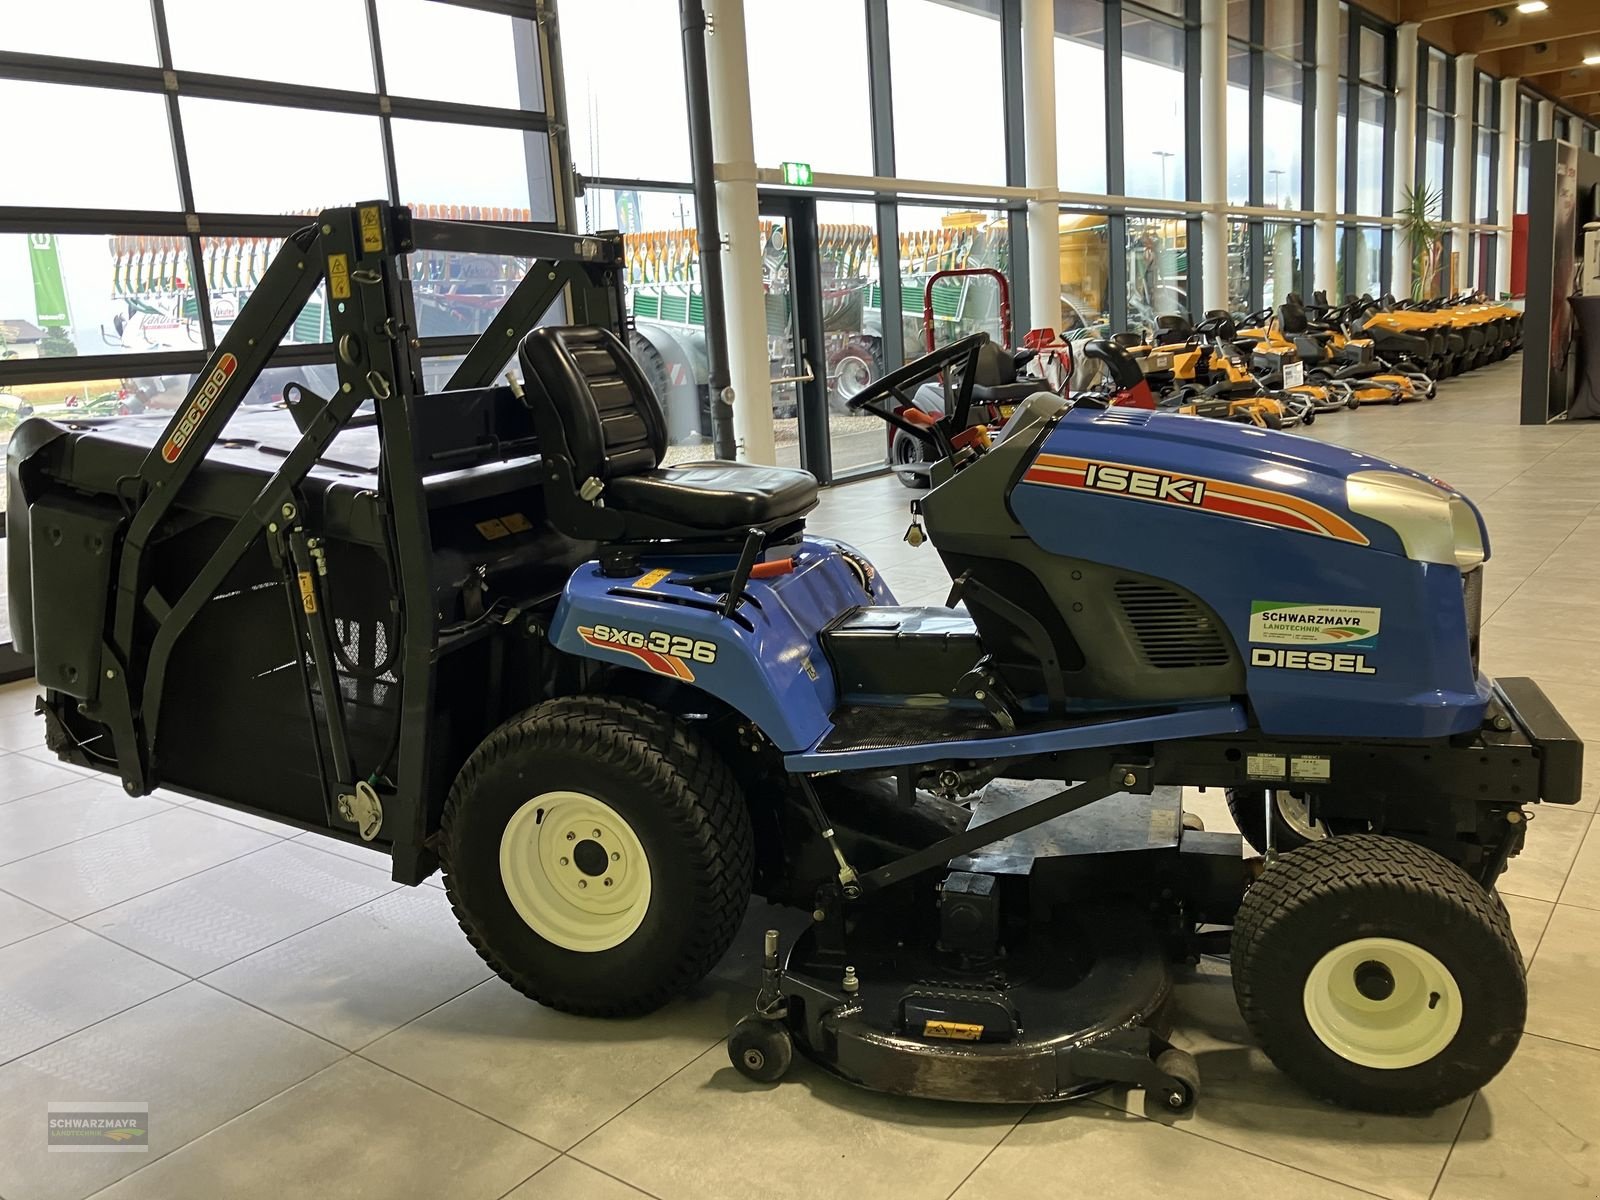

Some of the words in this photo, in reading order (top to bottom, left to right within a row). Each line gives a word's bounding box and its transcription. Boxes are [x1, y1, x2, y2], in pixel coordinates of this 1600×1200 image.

[172, 407, 201, 449] SBC
[197, 368, 227, 411] 600
[1085, 464, 1205, 505] ISEKI
[1262, 612, 1361, 626] SCHWARZMAYR
[1263, 623, 1321, 633] LANDTECHNIK
[593, 624, 645, 649] SXG
[648, 631, 717, 664] 326
[1251, 648, 1377, 674] DIESEL
